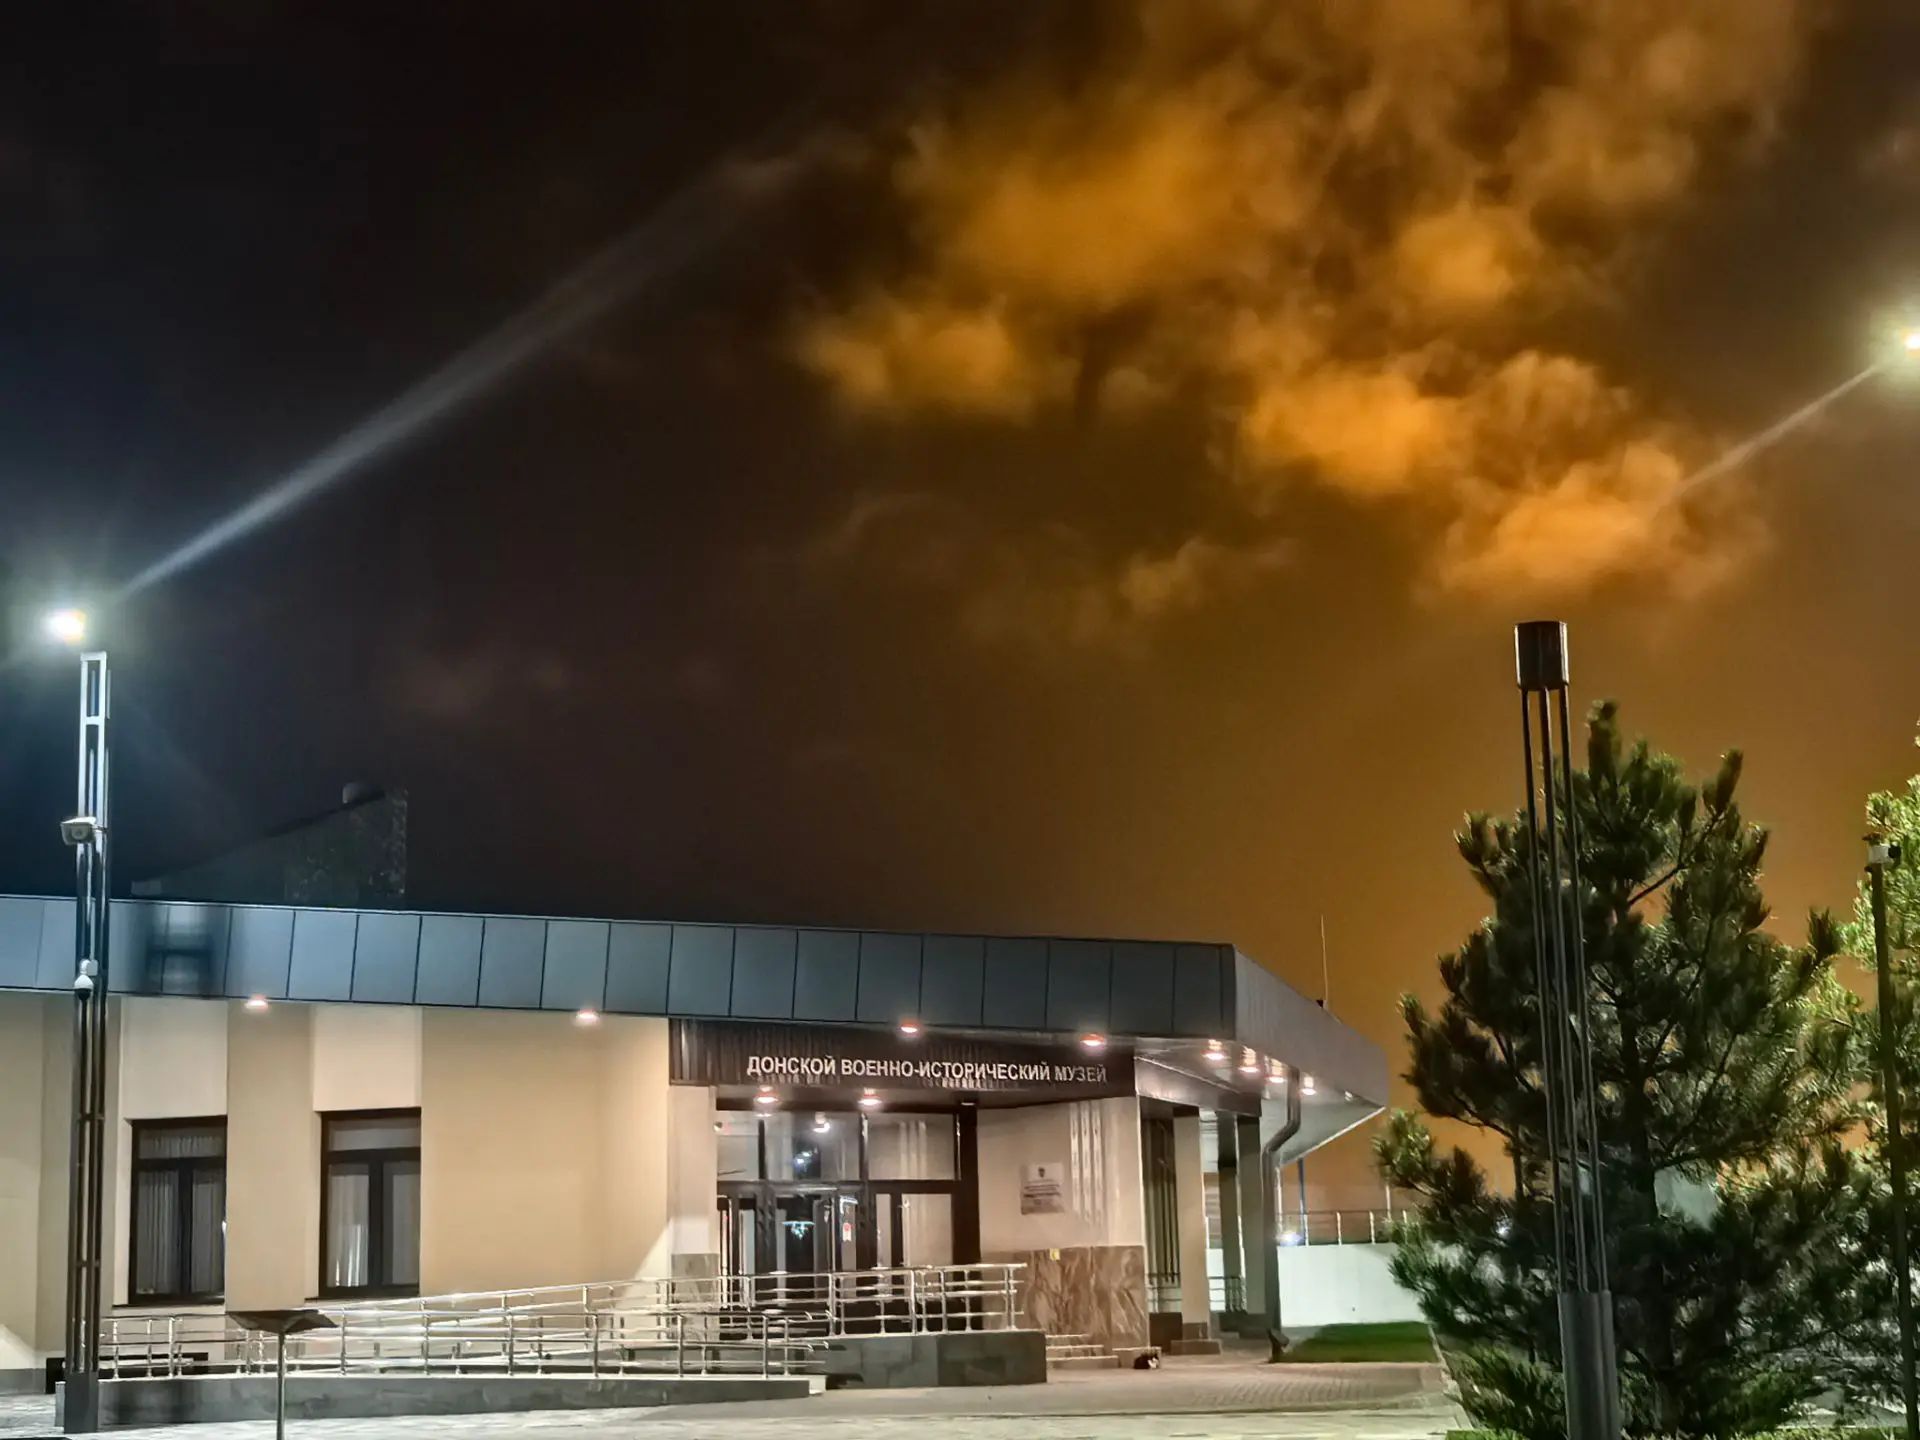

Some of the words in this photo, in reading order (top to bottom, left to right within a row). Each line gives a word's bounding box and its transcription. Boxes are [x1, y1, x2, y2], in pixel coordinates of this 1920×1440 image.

[746, 1055, 836, 1076] ДОНСКОЙ
[841, 1059, 1051, 1081] ВОЕННО-ИСТОРИЧЕСКИЙ
[1054, 1064, 1107, 1082] МУЗЕЙ
